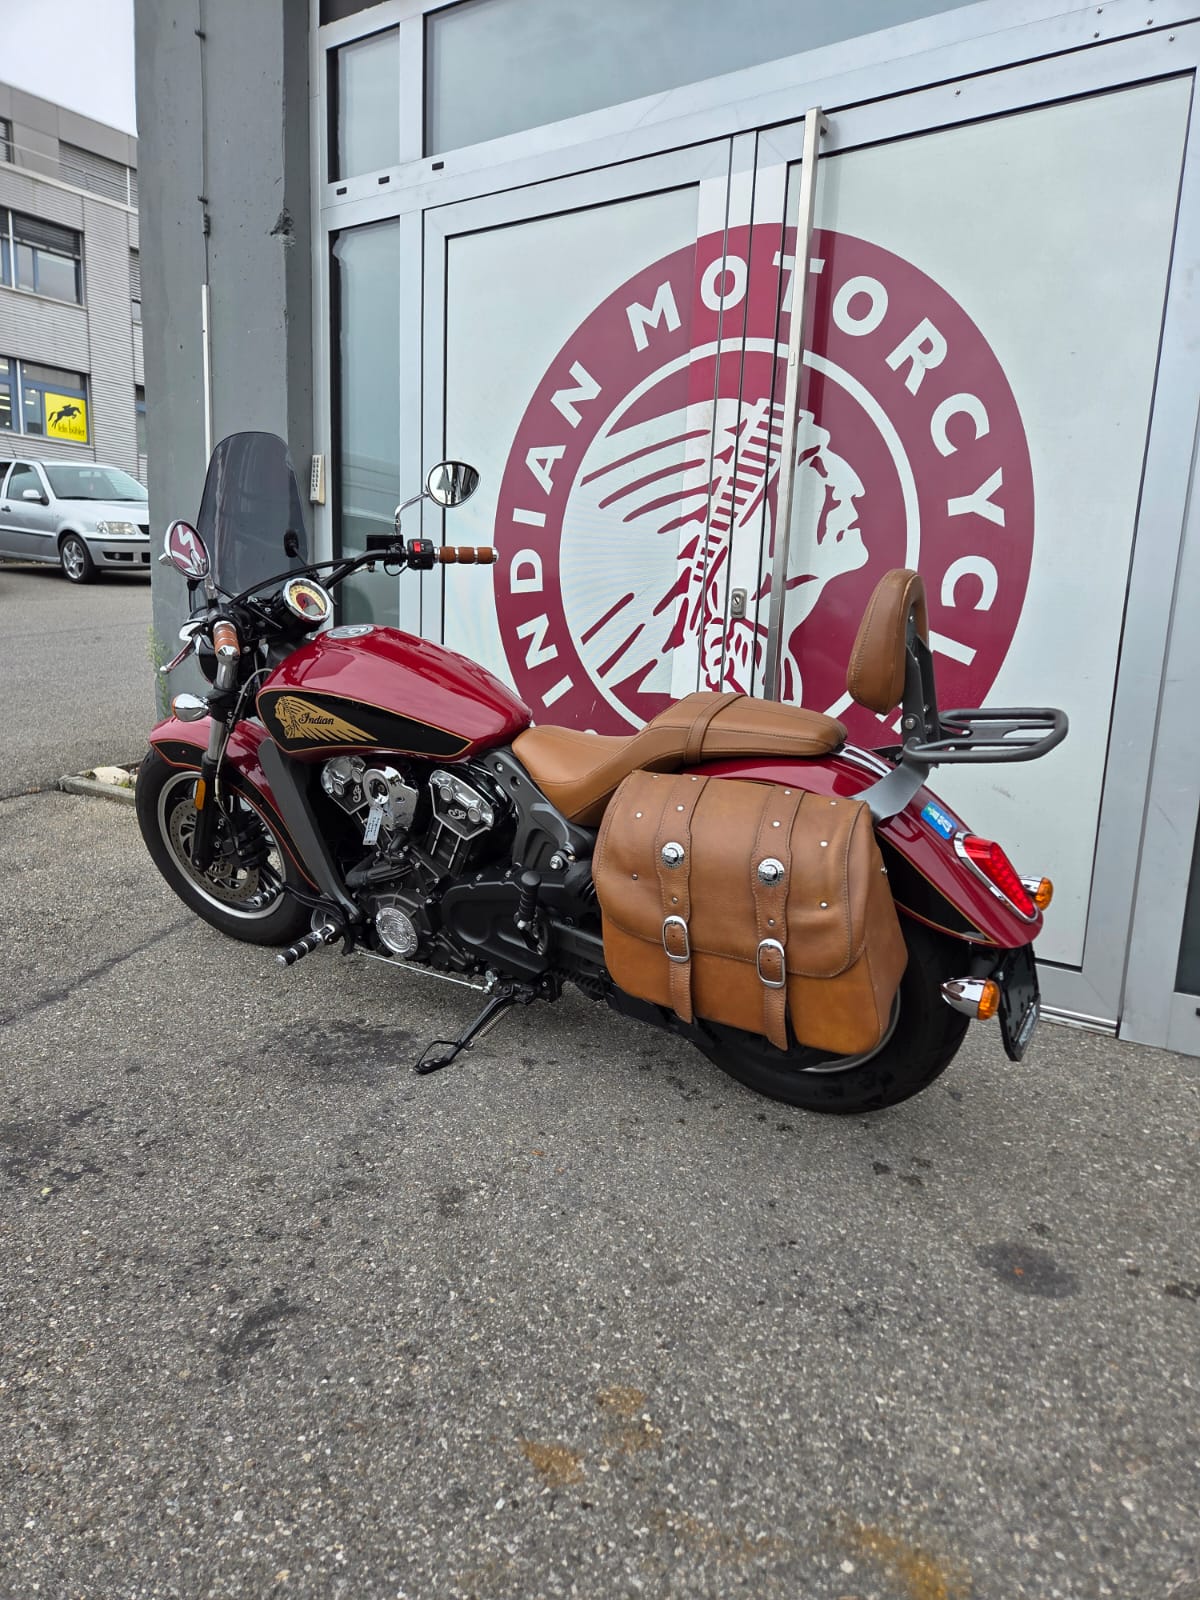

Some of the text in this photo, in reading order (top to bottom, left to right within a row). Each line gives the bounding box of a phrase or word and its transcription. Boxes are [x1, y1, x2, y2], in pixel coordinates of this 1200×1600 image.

[510, 250, 1006, 735] INDIAN MOTORCYCL
[299, 713, 334, 725] Indian
